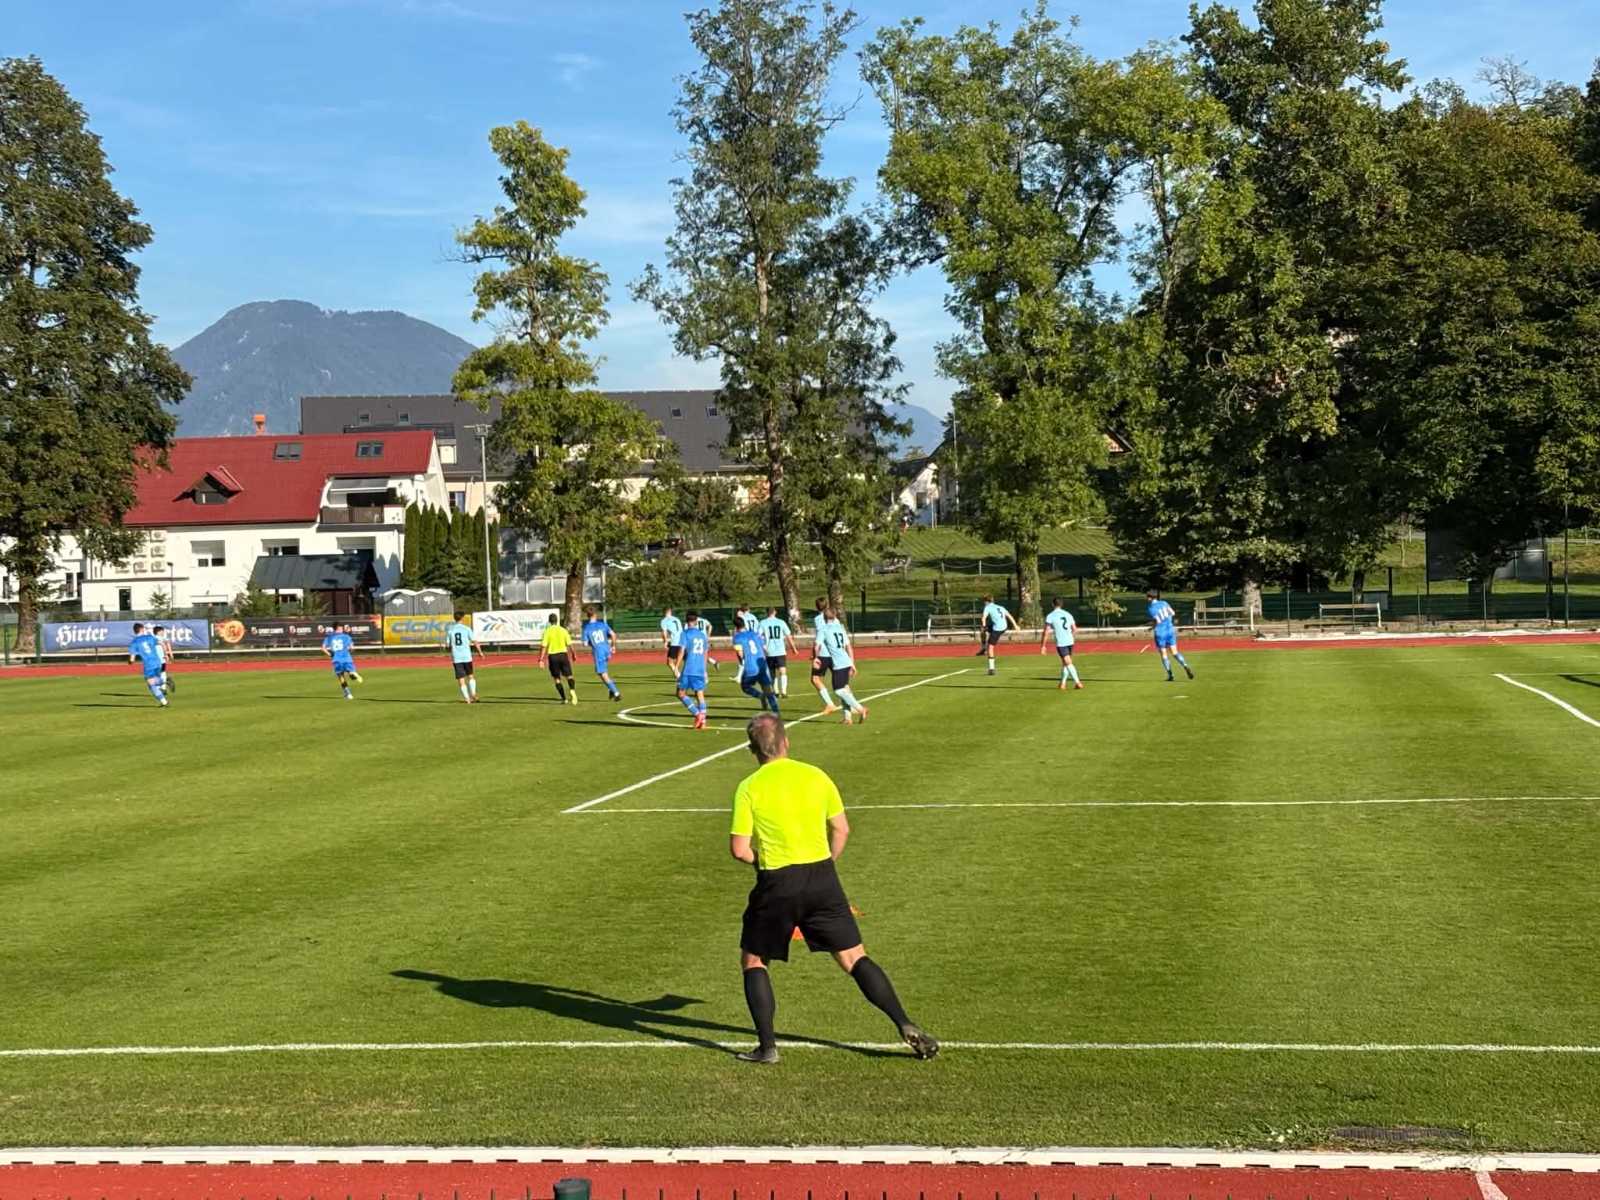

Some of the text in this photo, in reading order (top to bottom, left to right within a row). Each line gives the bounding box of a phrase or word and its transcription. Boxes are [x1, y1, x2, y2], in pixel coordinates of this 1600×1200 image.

[1060, 616, 1068, 630] 2
[56, 624, 109, 646] Hirter
[455, 632, 463, 646] 8
[768, 625, 780, 640] 10
